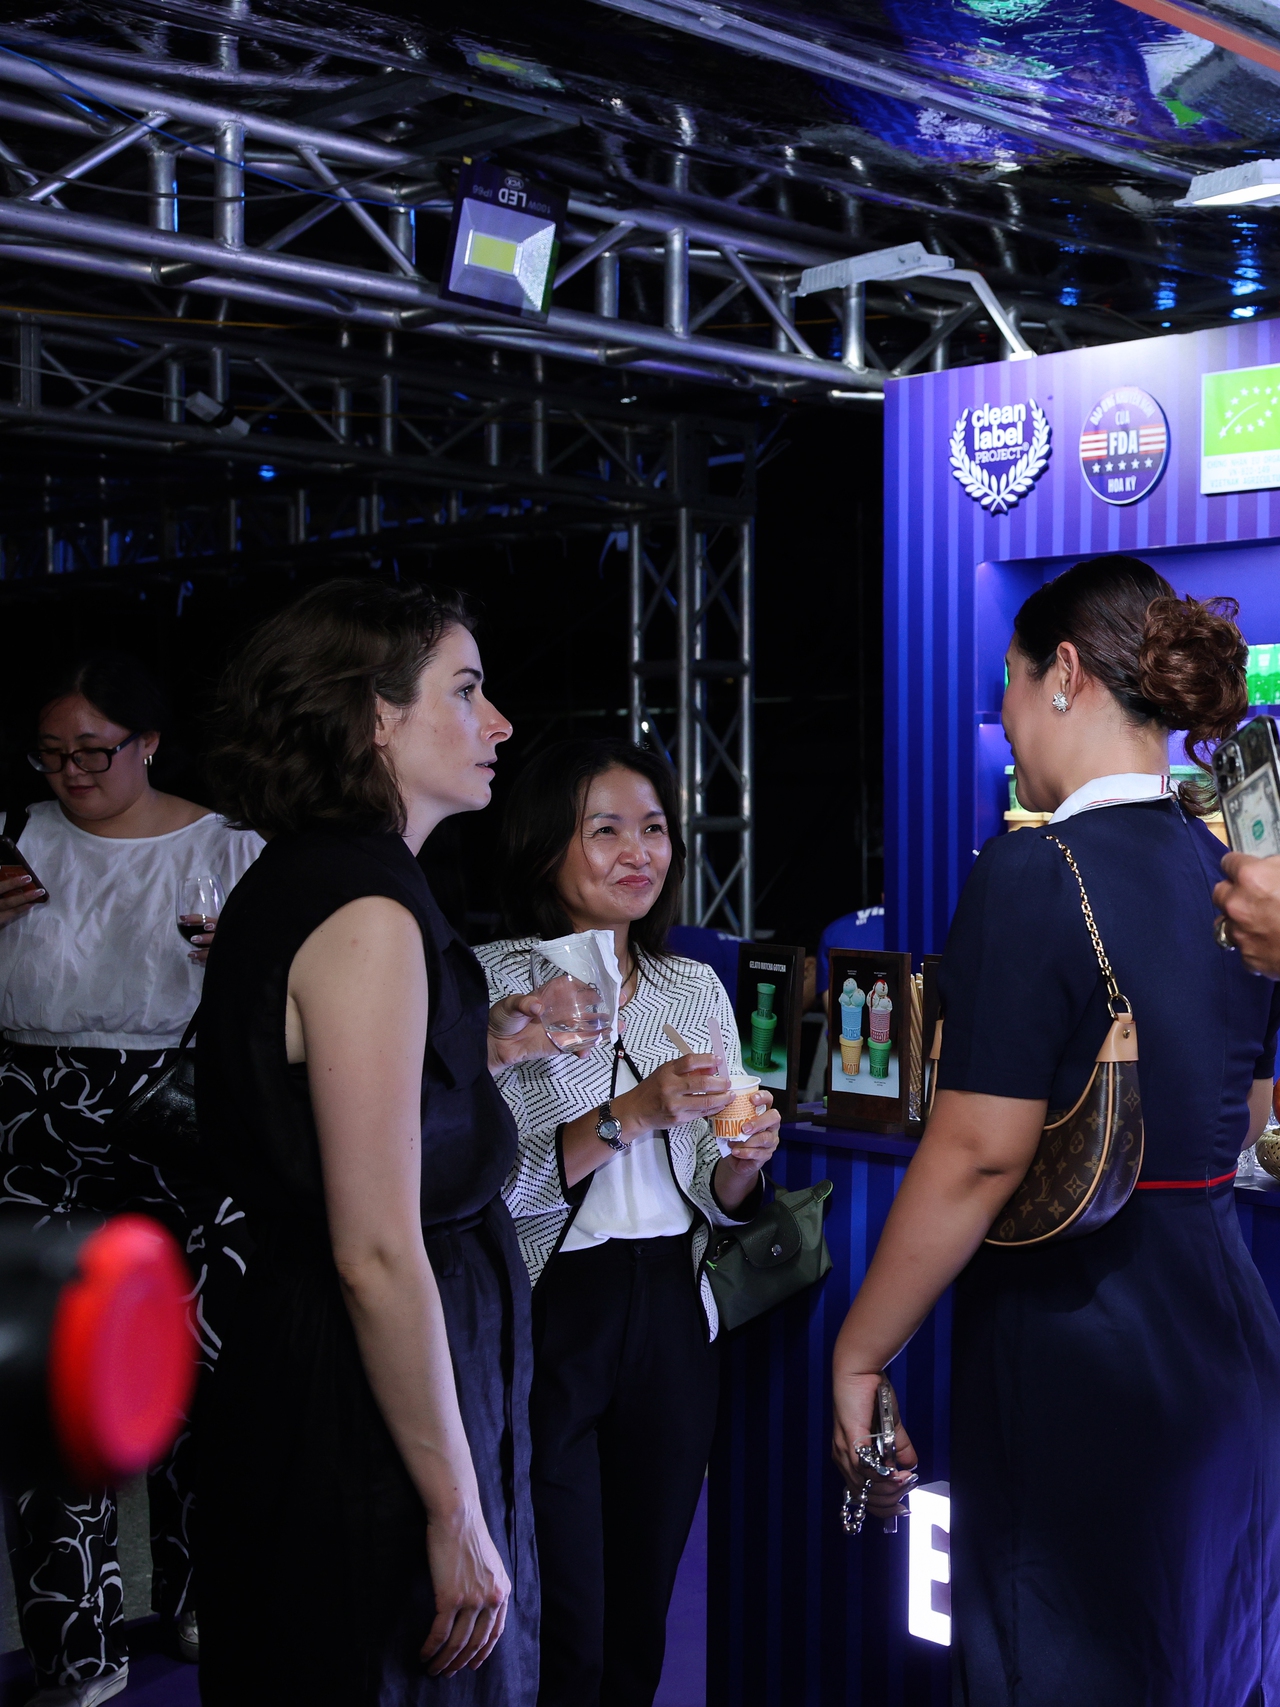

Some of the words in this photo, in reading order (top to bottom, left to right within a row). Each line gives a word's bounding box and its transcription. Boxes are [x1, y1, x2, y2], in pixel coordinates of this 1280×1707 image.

[498, 188, 527, 208] LED
[972, 403, 1026, 428] clean
[974, 420, 1023, 450] label
[1108, 430, 1138, 456] FDA
[974, 446, 1023, 464] PROJECT
